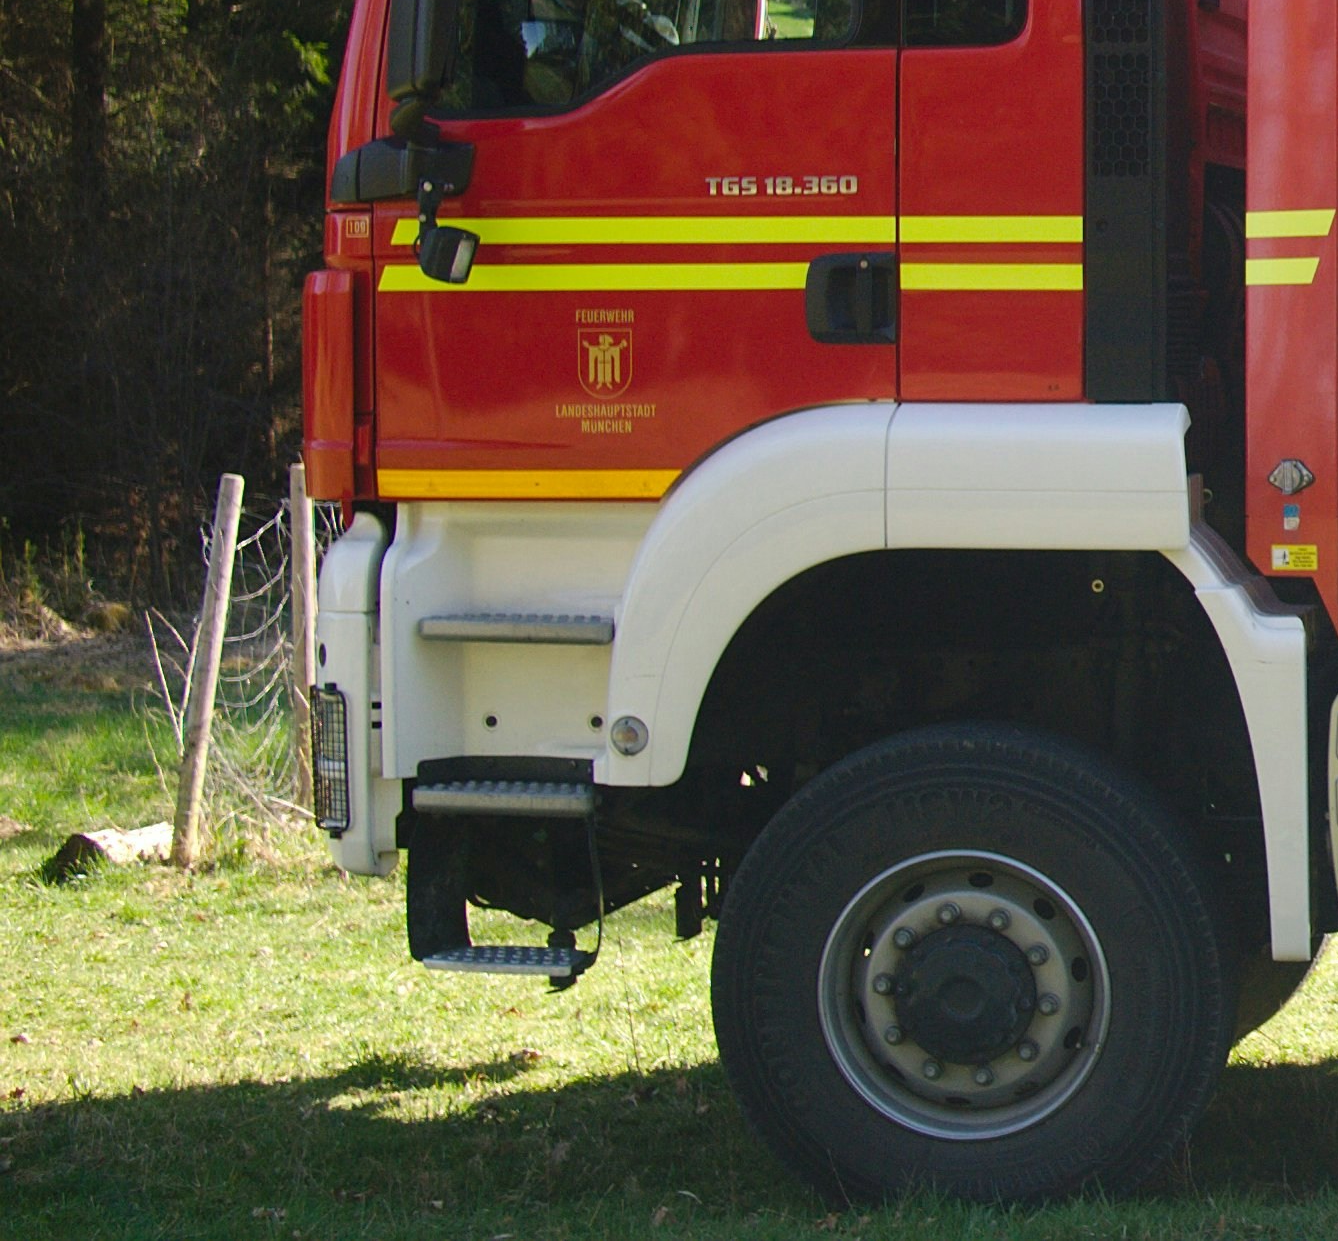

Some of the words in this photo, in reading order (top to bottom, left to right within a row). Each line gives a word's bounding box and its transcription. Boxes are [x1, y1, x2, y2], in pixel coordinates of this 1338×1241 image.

[705, 176, 758, 196] TGS
[764, 175, 858, 195] 18.360
[575, 309, 635, 324] FEUERWEHR
[555, 404, 657, 418] LANDESHAUPTSTADT
[581, 419, 632, 434] MÜNCHEN
